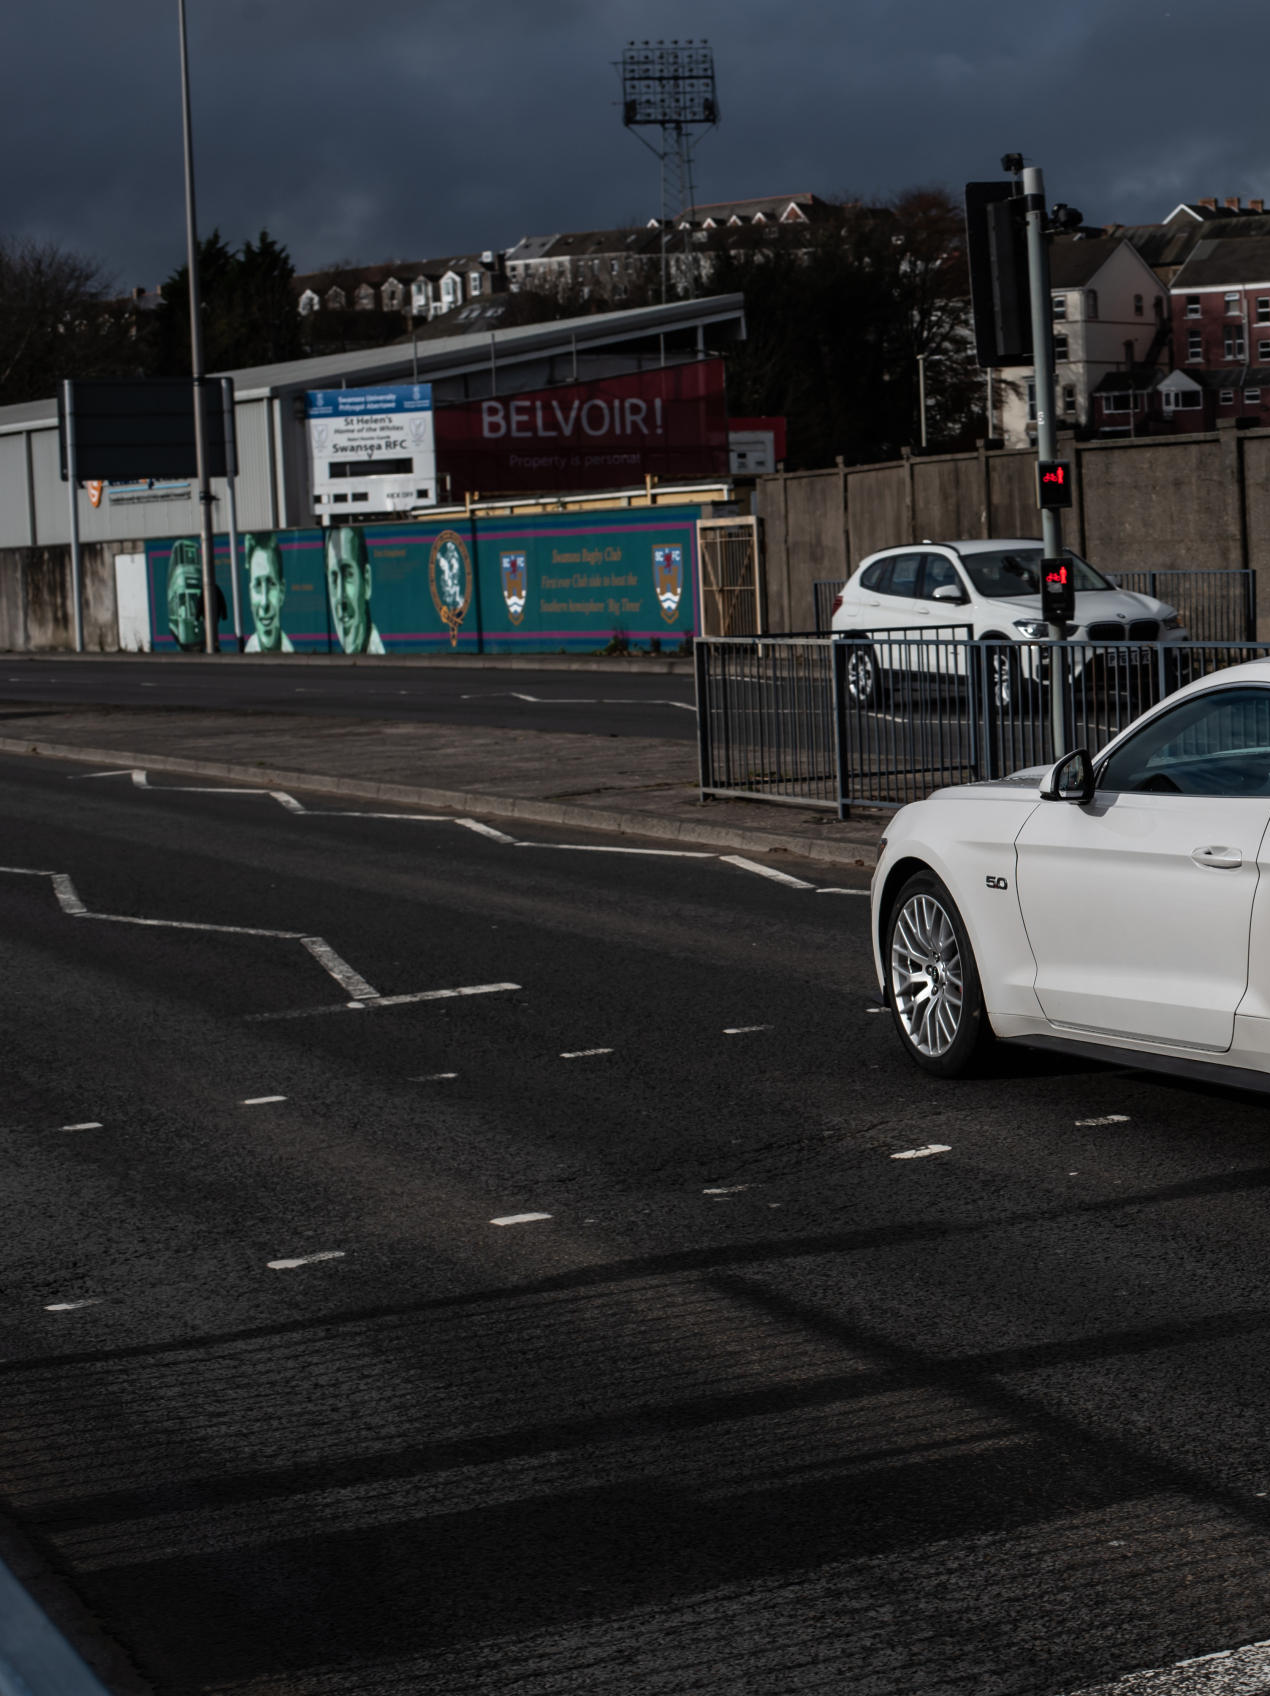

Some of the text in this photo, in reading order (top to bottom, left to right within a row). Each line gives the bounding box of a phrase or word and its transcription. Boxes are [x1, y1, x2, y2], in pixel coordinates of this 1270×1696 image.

[366, 394, 396, 403] University
[344, 415, 393, 426] St Helen's
[481, 397, 663, 439] BELVOIR!
[334, 427, 355, 435] Home
[365, 425, 377, 433] the
[379, 424, 404, 432] Whites
[332, 439, 408, 454] Swansea RFC
[509, 451, 642, 469] Property is personal
[401, 491, 414, 499] OFF
[552, 546, 622, 566] Swansea Rugby Club
[541, 575, 557, 589] First
[572, 573, 588, 588] Club
[588, 572, 602, 587] side
[611, 572, 626, 587] beat
[626, 571, 638, 586] the
[540, 598, 568, 613] Southern
[985, 875, 1008, 890] 5.0
